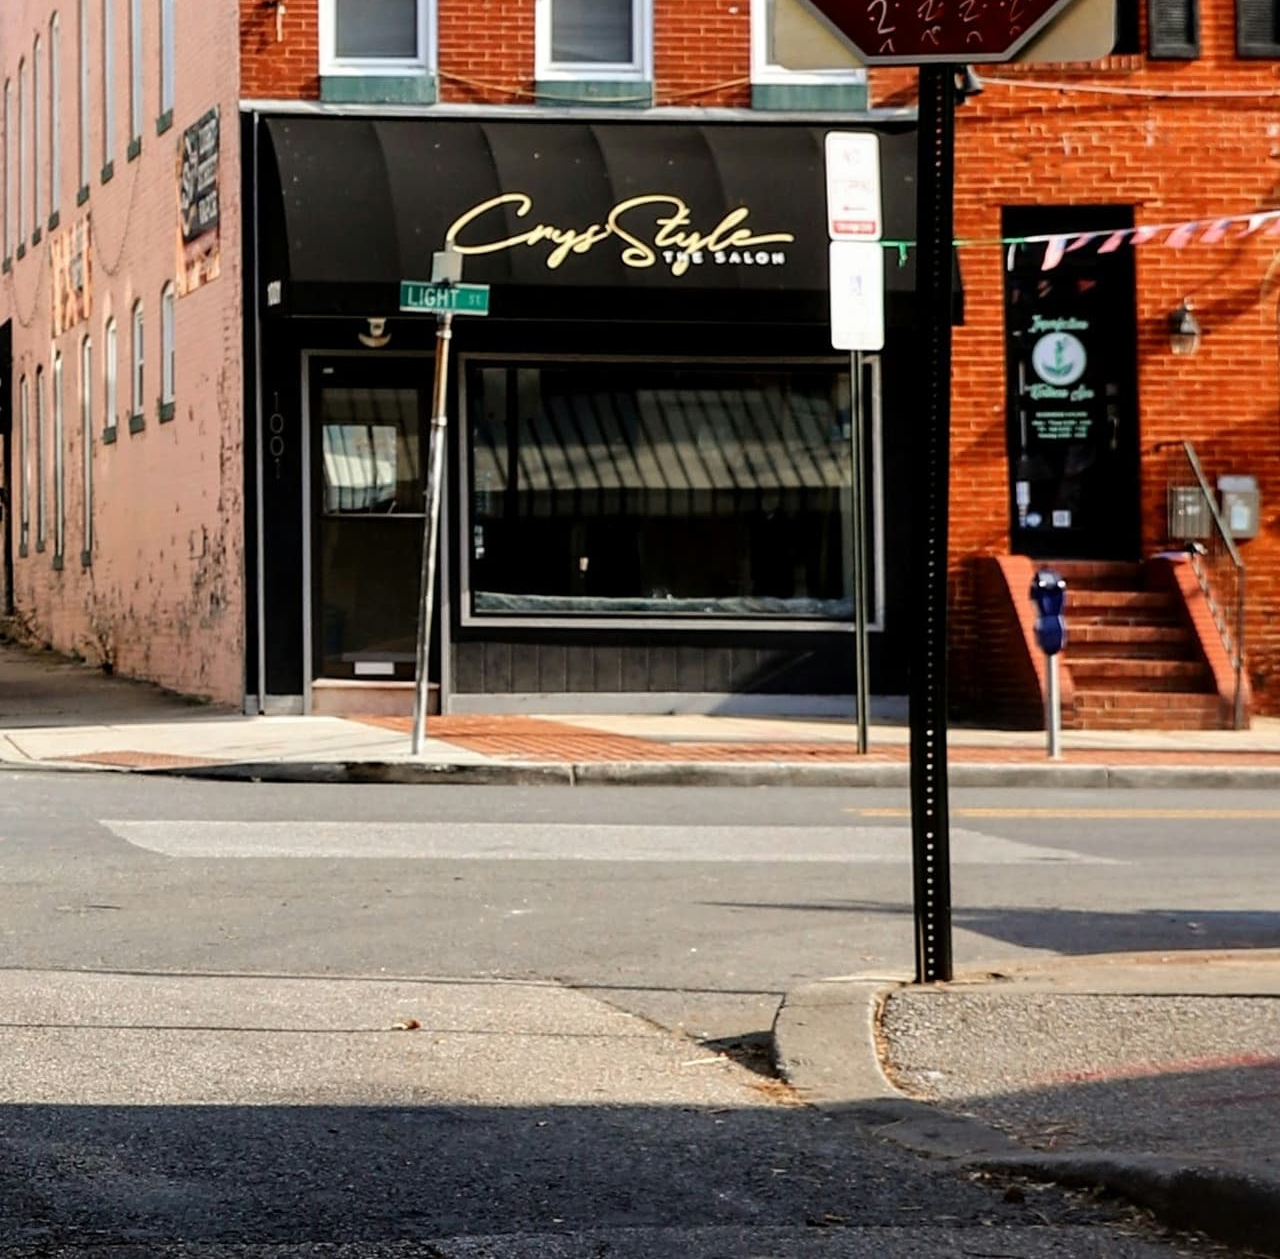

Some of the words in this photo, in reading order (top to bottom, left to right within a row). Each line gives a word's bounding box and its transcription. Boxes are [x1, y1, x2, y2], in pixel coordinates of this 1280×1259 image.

[662, 251, 703, 265] THE
[715, 251, 785, 265] SALON
[407, 287, 460, 309] LIGHT
